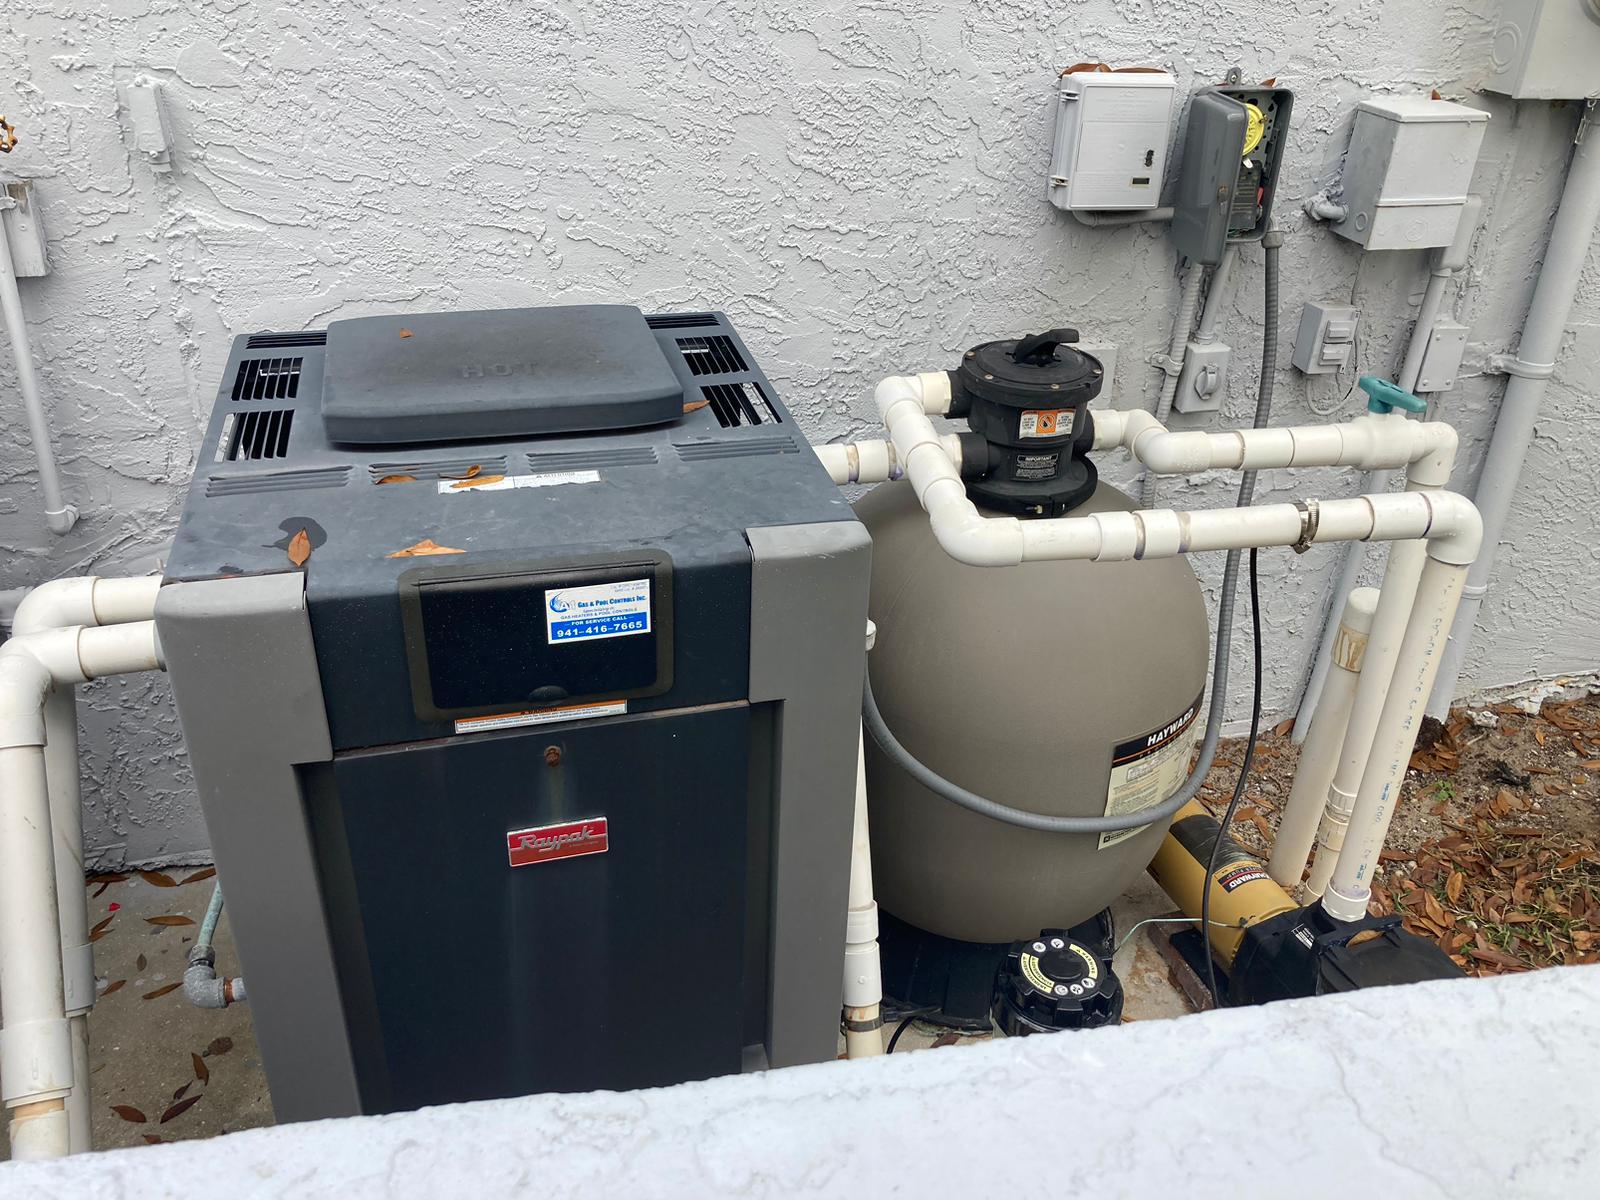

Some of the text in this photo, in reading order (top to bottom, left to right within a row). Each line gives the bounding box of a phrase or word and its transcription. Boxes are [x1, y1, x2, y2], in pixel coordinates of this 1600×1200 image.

[463, 363, 538, 378] HOT
[557, 621, 642, 637] 941-416-7665
[1148, 708, 1194, 746] HAYWARD
[518, 826, 594, 852] Raypak
